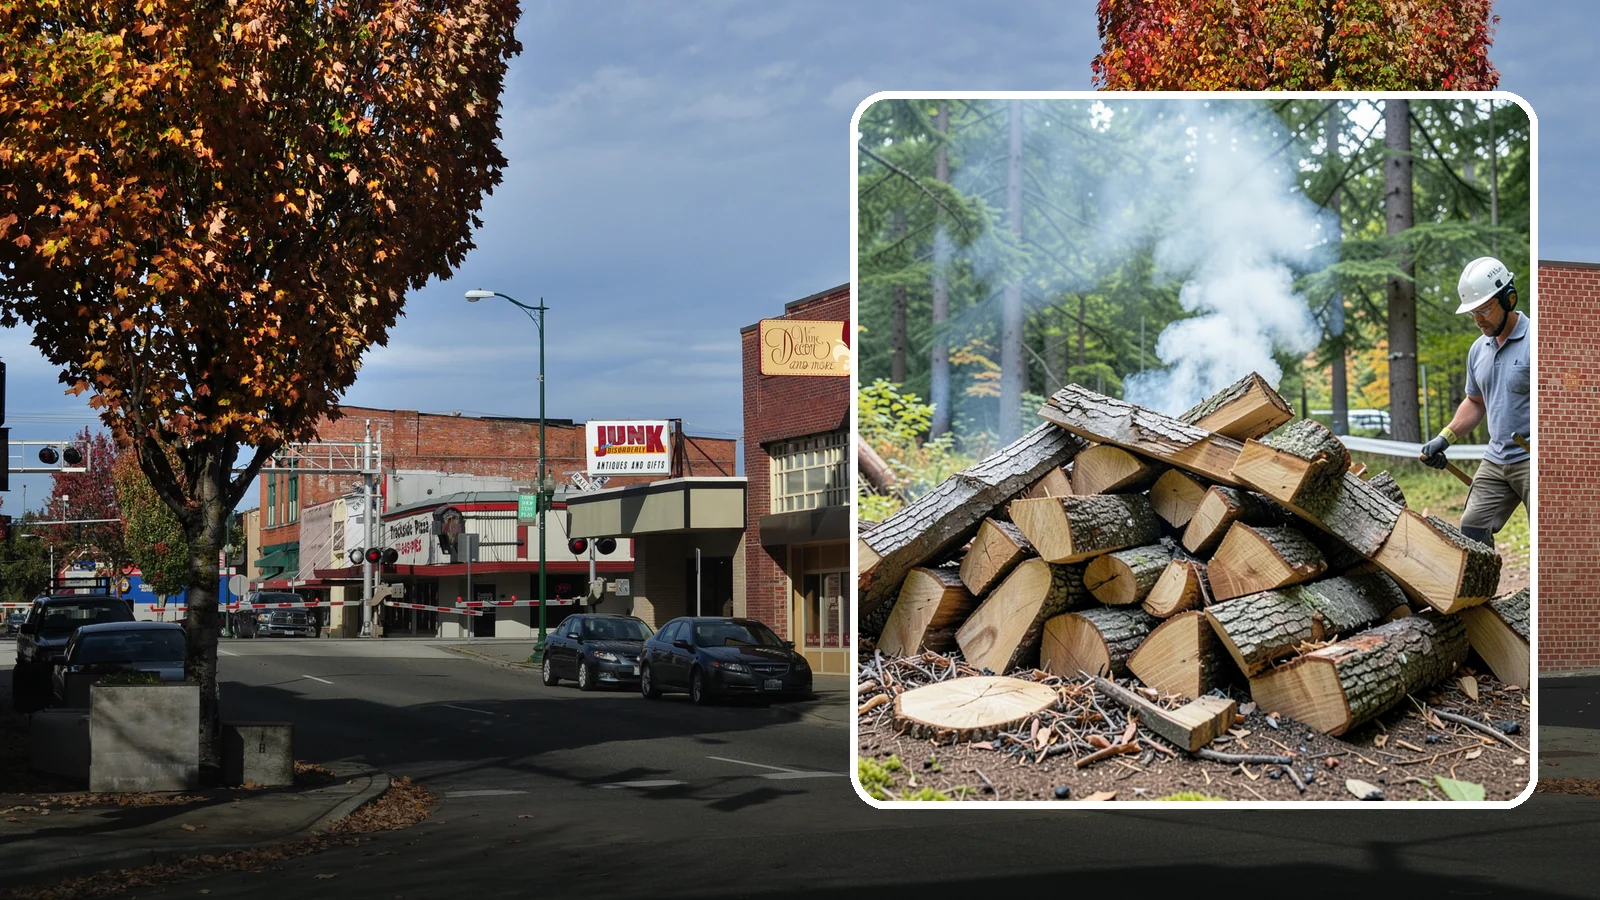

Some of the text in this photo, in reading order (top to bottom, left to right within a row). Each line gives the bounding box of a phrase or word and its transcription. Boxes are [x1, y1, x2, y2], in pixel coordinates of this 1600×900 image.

[596, 425, 665, 457] JUNK
[608, 446, 646, 454] DISORDERLY
[596, 460, 665, 470] ANTIQUES AND GIFTS
[390, 520, 429, 539] Trackside Pizza
